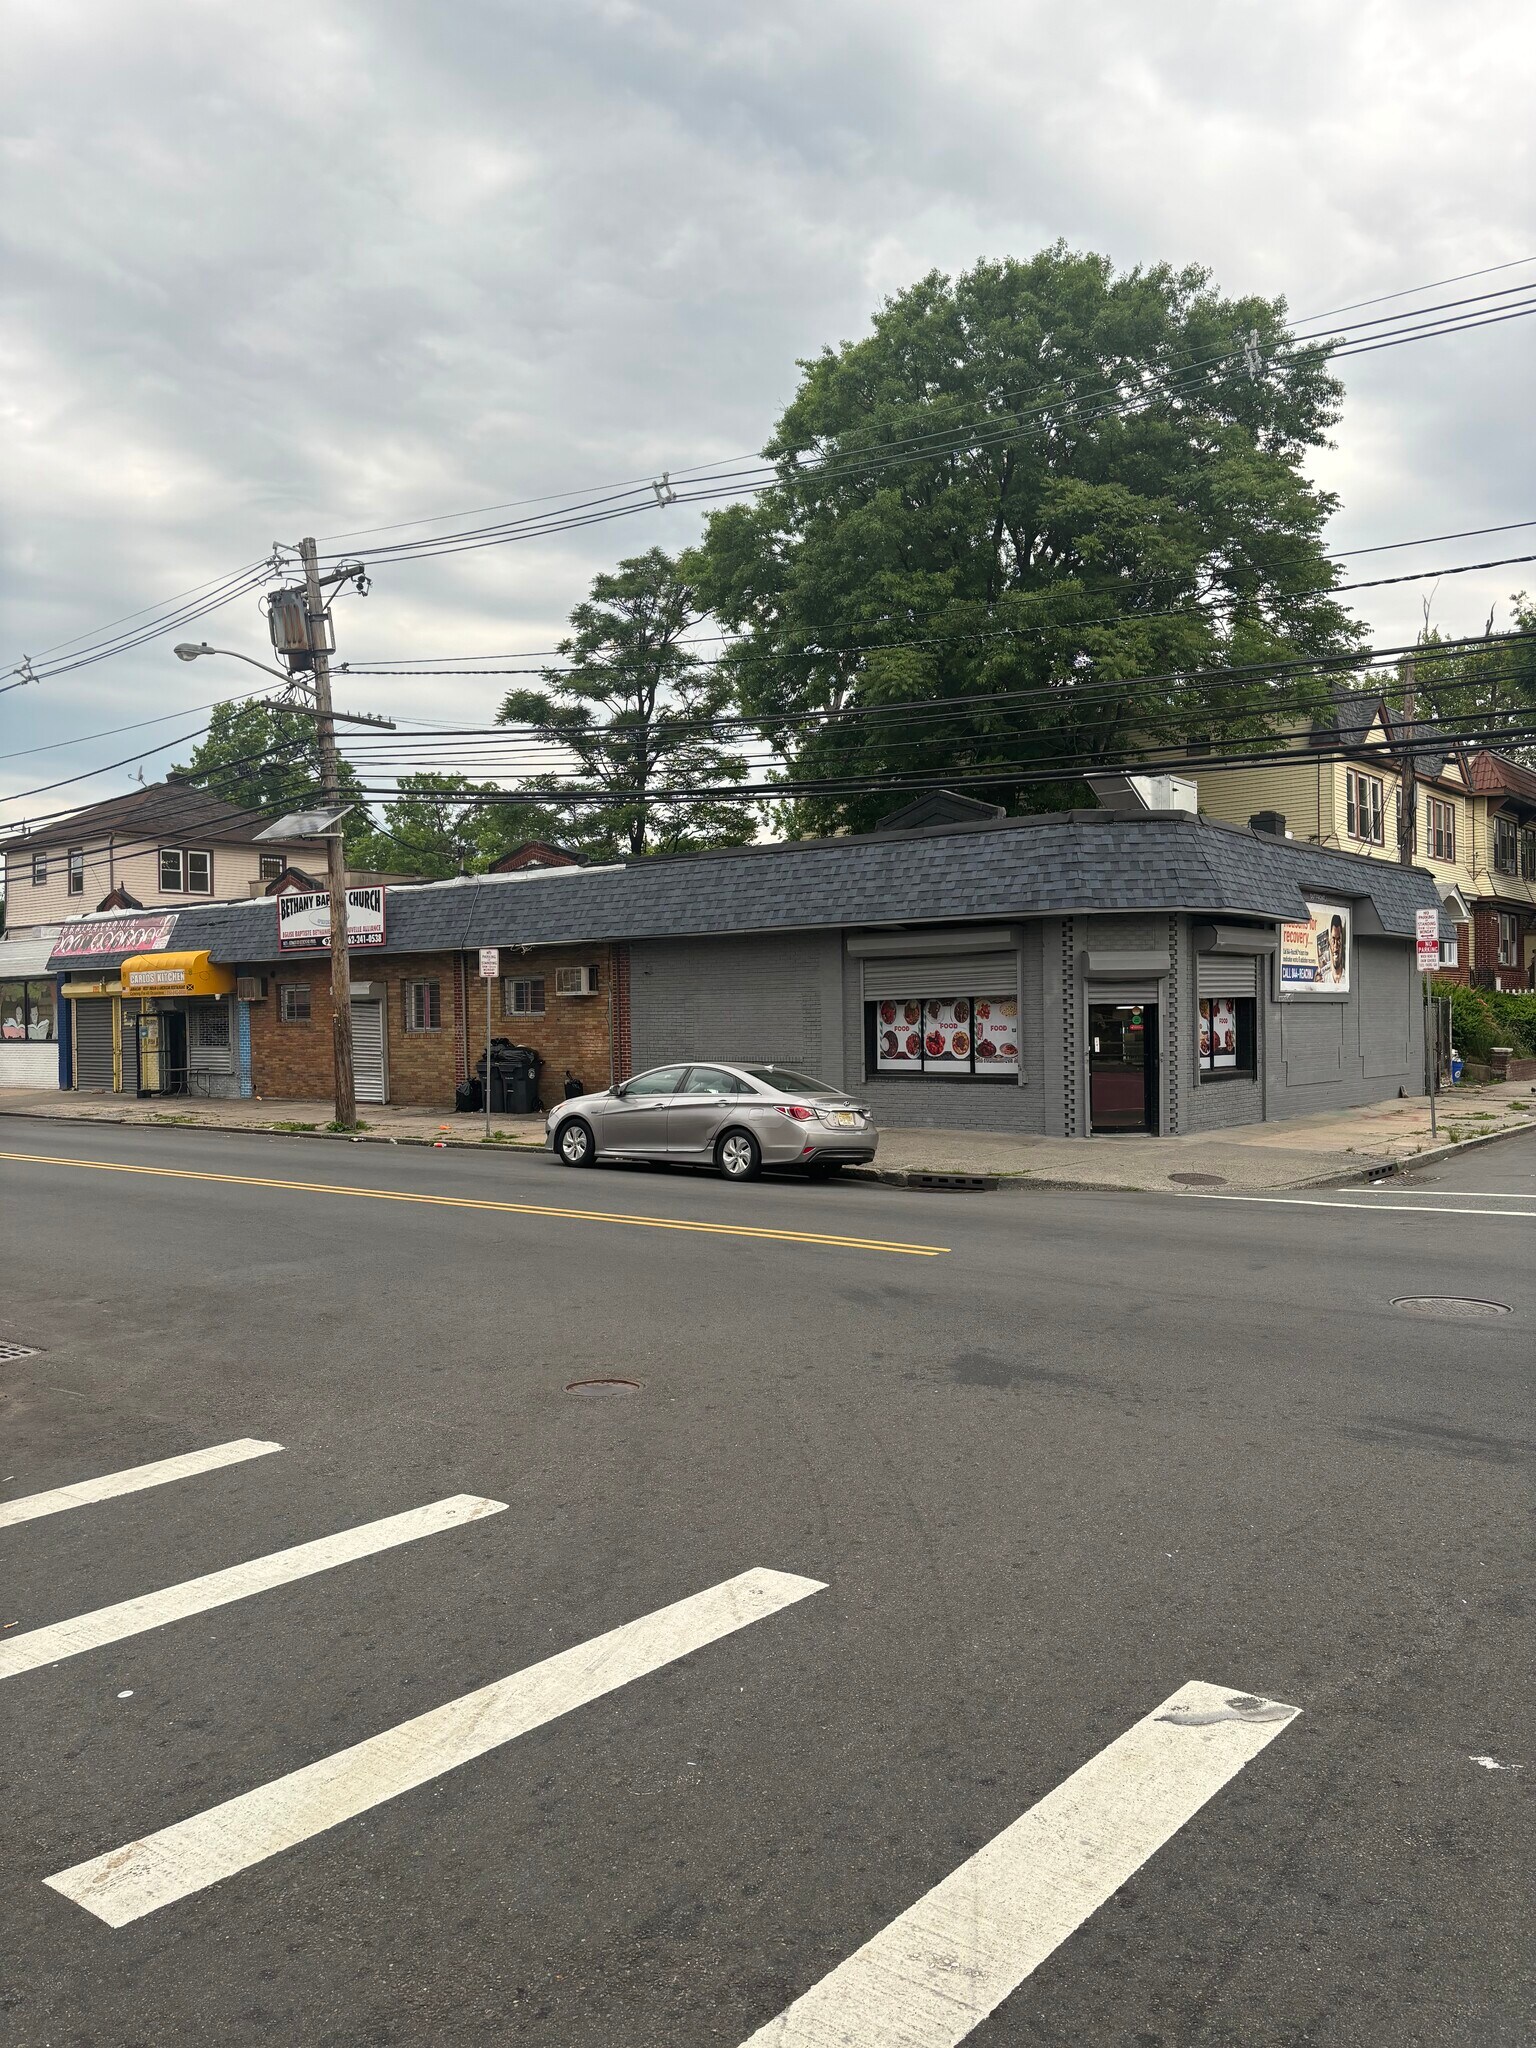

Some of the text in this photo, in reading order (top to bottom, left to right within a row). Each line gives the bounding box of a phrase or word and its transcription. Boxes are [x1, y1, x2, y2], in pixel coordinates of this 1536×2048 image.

[281, 896, 314, 920] BETHANY
[348, 890, 381, 913] CHURCH
[157, 970, 185, 983] KITCHEN
